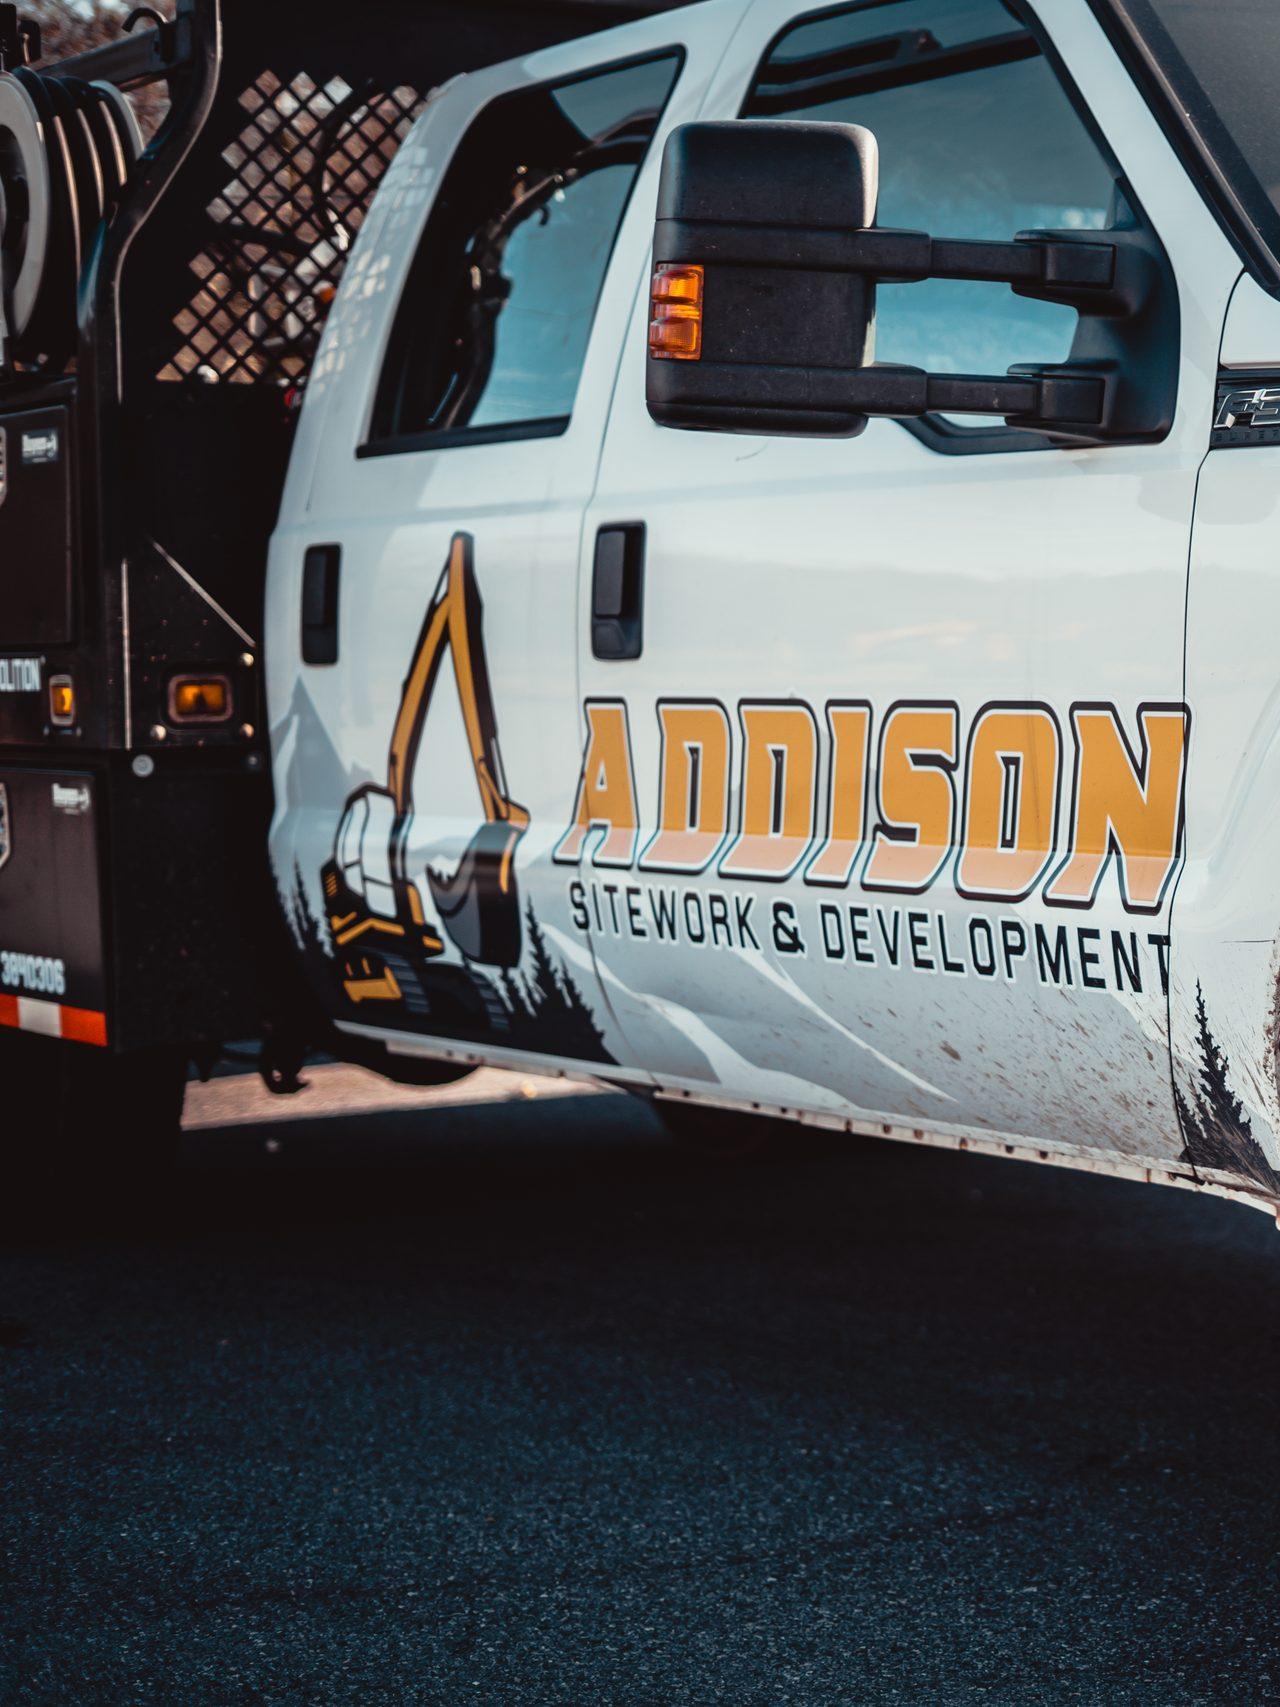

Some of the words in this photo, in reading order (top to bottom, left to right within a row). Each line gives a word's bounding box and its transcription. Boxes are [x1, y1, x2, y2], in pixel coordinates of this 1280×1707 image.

[553, 697, 1191, 916] ADDISON
[570, 881, 760, 950] SITEWORK
[773, 902, 805, 953] &
[820, 903, 1171, 996] DEVELOPMENT
